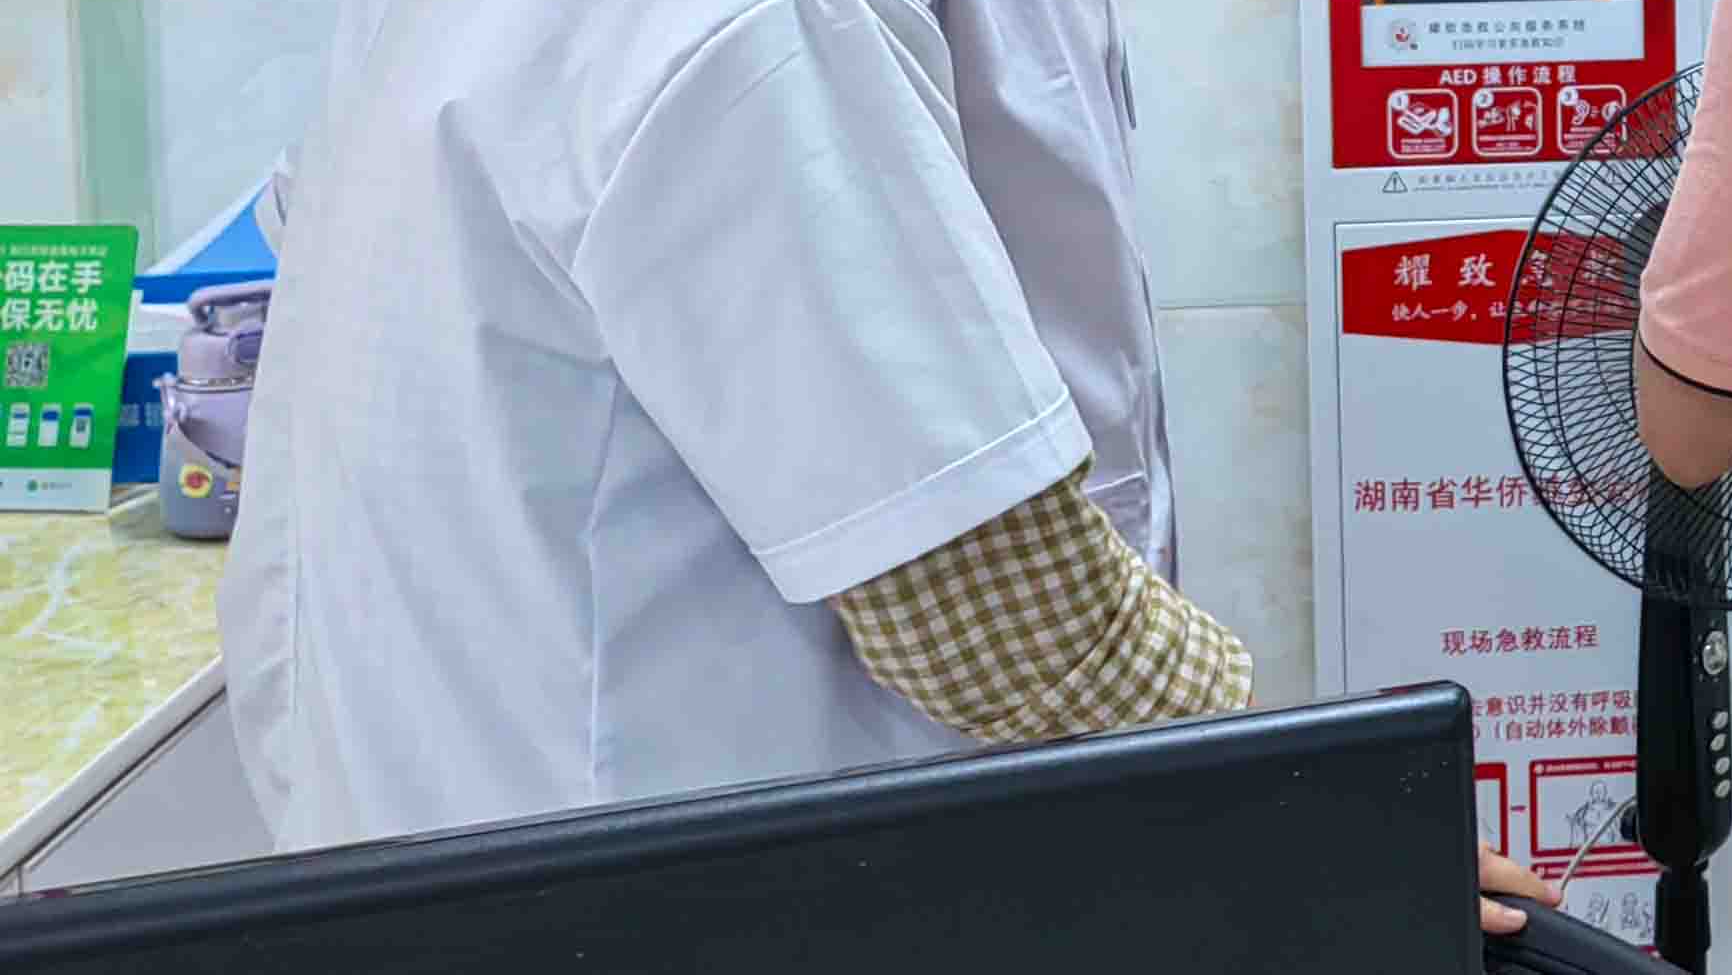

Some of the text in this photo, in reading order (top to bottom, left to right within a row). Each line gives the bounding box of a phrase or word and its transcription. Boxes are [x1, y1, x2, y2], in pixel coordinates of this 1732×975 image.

[1440, 65, 1577, 86] AED 操作流程
[0, 260, 103, 294] 码在手
[1442, 625, 1599, 656] 现场急救流程
